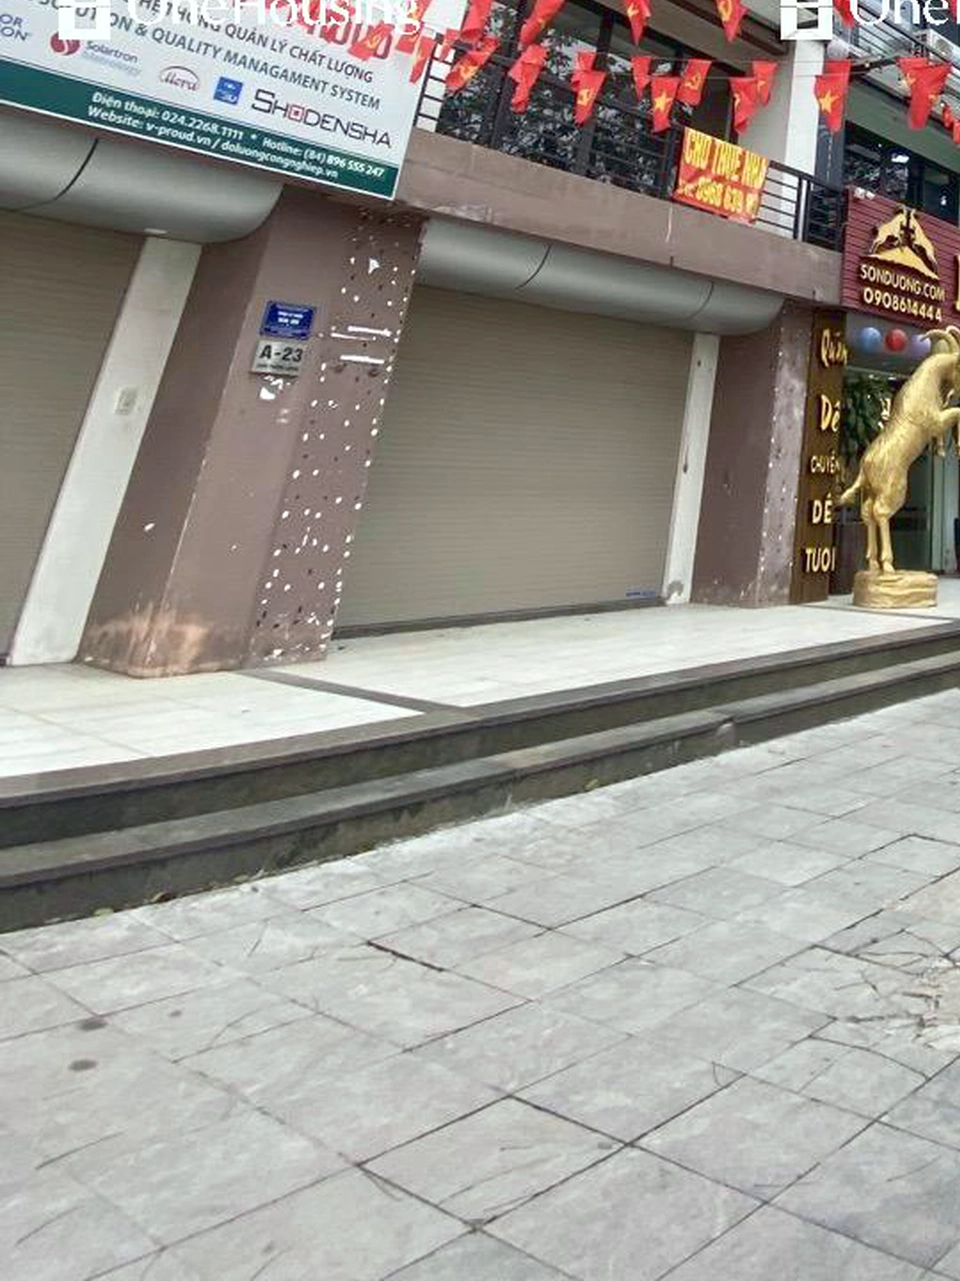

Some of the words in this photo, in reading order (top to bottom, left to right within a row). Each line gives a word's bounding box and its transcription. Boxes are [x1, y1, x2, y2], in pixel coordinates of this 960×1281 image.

[85, 40, 138, 64] Solartron
[134, 21, 149, 37] &
[152, 26, 224, 60] QUALITY
[223, 48, 329, 92] MANAGAMENT
[330, 83, 381, 111] SYSTEM
[87, 105, 144, 130] Website:
[145, 123, 212, 148] v-proud.vn
[251, 88, 392, 149] SHODENSHA
[326, 155, 346, 169] 896
[860, 263, 946, 302] SONDUONG.COM
[863, 286, 942, 322] 0908614444
[258, 344, 304, 364] A-23
[820, 393, 841, 433] Dê
